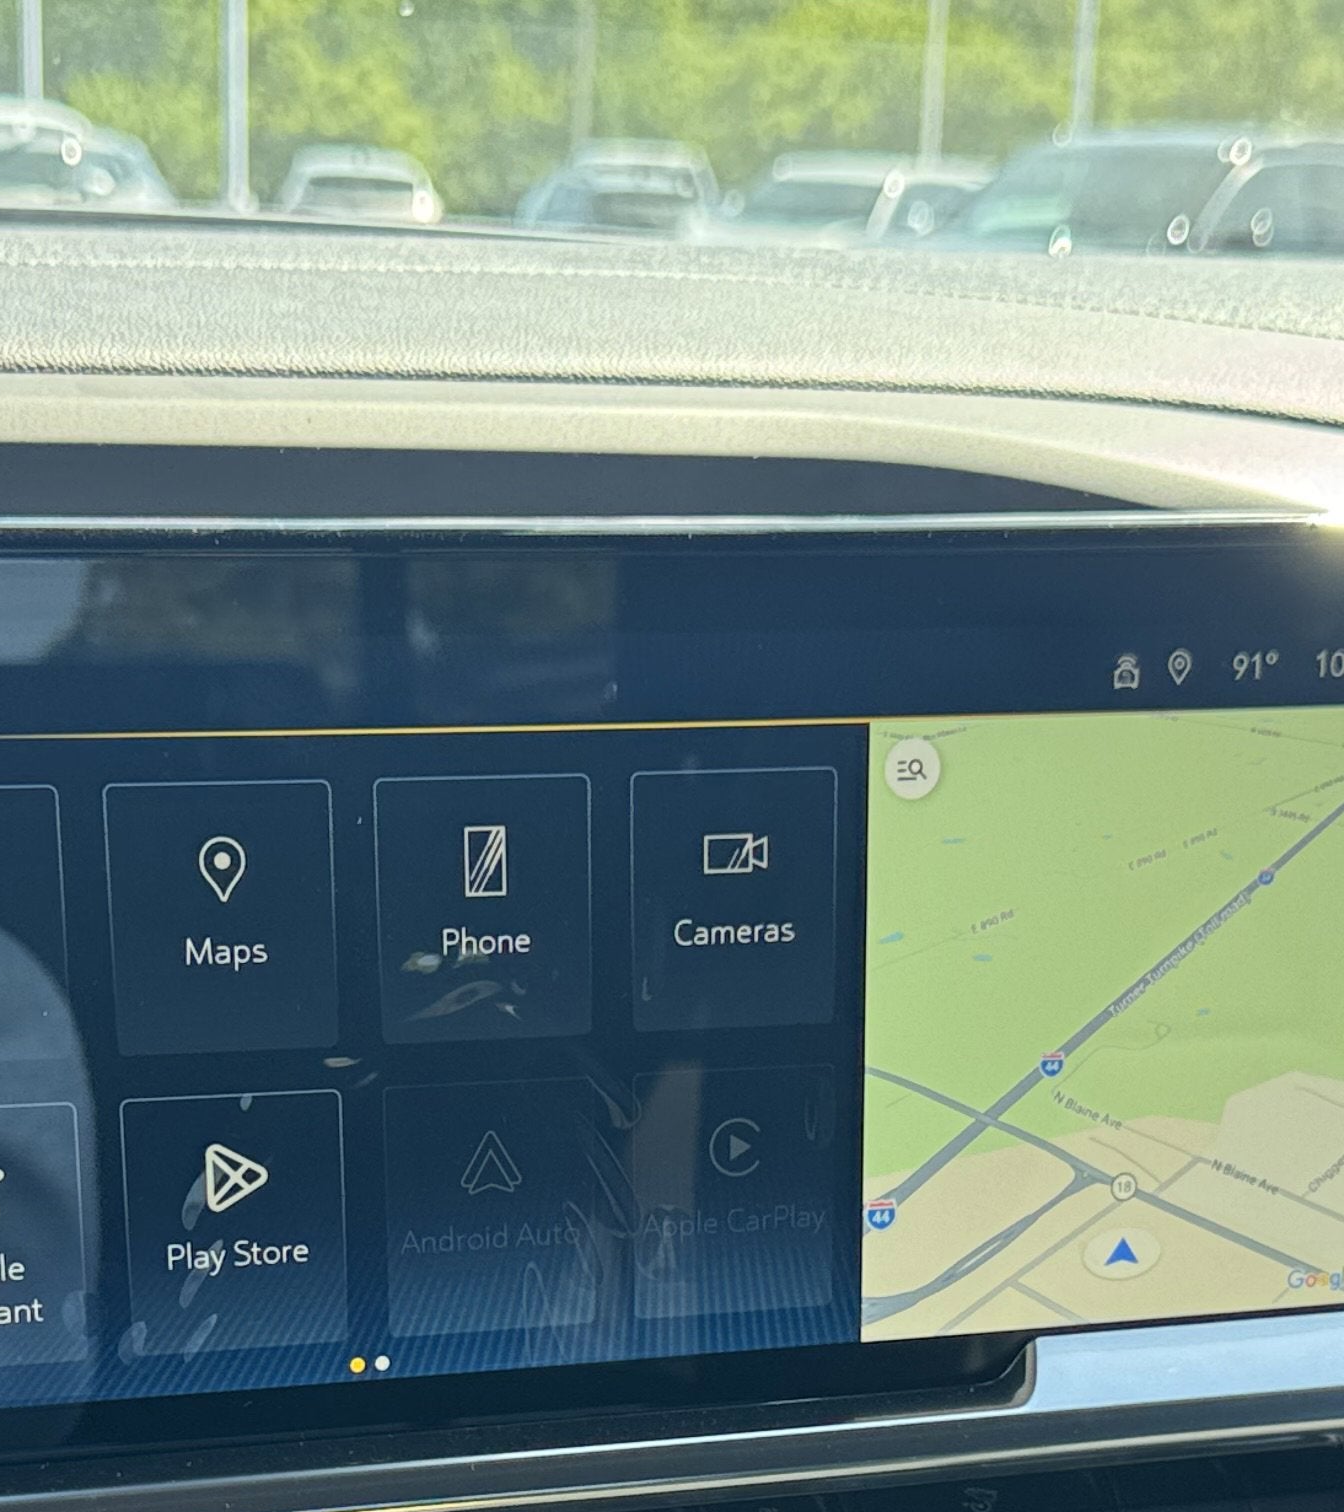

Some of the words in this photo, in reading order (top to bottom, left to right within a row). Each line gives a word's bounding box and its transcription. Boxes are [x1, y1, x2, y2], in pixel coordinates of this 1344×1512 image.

[1232, 650, 1279, 680] 91°
[441, 927, 532, 956] Phone
[673, 919, 796, 946] Cameras
[185, 937, 268, 971] Maps
[1054, 1090, 1065, 1104] N
[1064, 1098, 1100, 1121] Blaine
[1101, 1113, 1122, 1130] Ave
[1117, 1179, 1131, 1194] 18
[1211, 1159, 1223, 1171] N
[1223, 1163, 1257, 1185] Blaine
[1258, 1179, 1279, 1195] Ave
[642, 1210, 718, 1244] Apple
[726, 1203, 826, 1235] CarPlay
[871, 1210, 890, 1224] 44
[401, 1223, 508, 1256] Android
[516, 1221, 581, 1248] Auto
[167, 1243, 226, 1276] Play
[233, 1239, 309, 1268] Store
